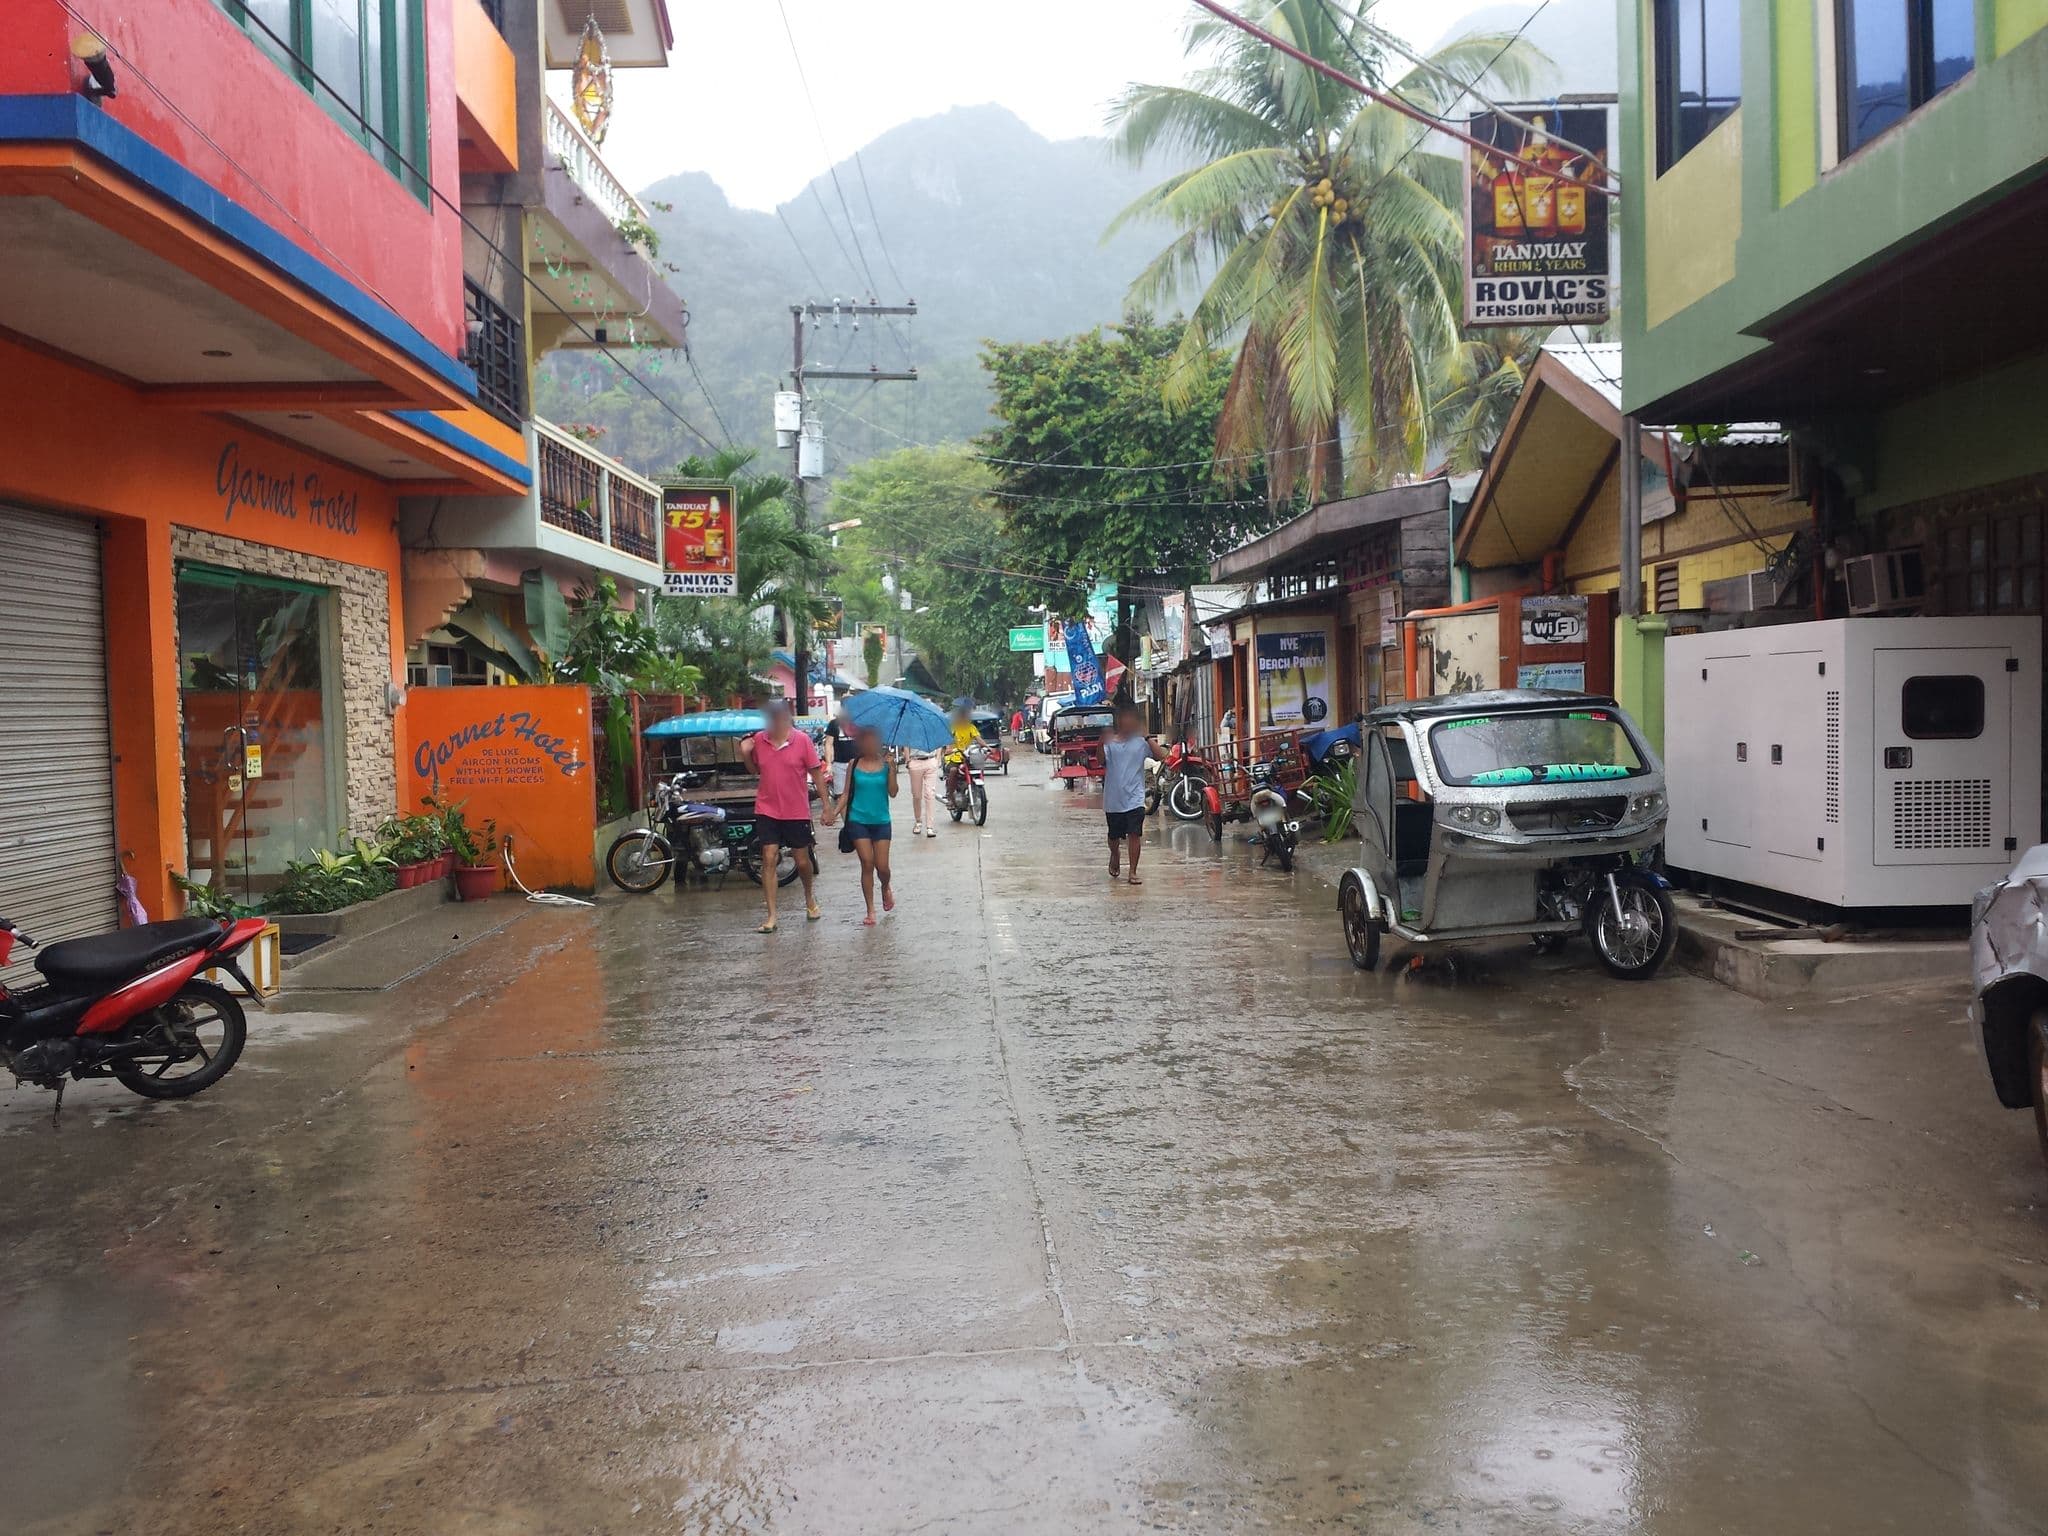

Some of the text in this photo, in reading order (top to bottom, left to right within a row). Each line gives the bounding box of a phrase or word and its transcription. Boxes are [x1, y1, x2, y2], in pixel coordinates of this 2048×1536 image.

[1493, 243, 1586, 260] TANDUAY
[1494, 261, 1533, 273] RHUM
[1545, 259, 1587, 271] YEARS
[1475, 278, 1607, 302] ROVIC'S
[1475, 302, 1606, 317] PENSION HOUSE
[216, 440, 359, 536] Garnet Hotel
[665, 502, 708, 511] TANDUAY
[667, 510, 705, 529] T5
[663, 574, 734, 586] ZANIYA'S
[669, 586, 729, 594] PENSION
[1280, 638, 1299, 651] NYE
[415, 712, 586, 796] Garnet Hotel
[481, 748, 520, 757] DE LUXE
[462, 757, 541, 767] AIRCON ROOMS
[455, 766, 544, 776] WITH HOT SHOWER
[450, 776, 475, 785] FREE
[507, 776, 546, 784] ACCESS
[145, 945, 195, 971] HONDA
